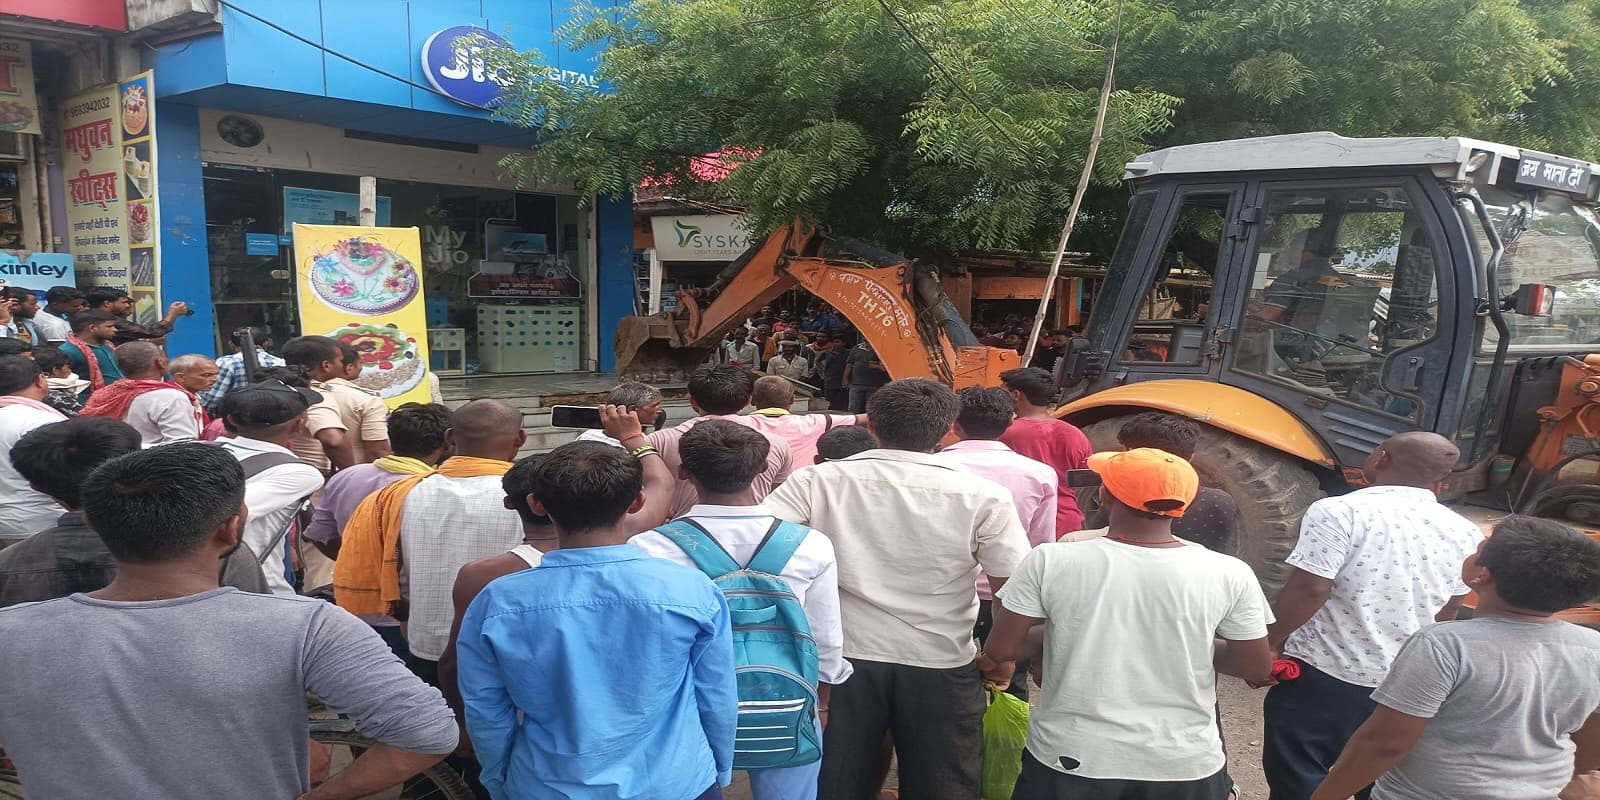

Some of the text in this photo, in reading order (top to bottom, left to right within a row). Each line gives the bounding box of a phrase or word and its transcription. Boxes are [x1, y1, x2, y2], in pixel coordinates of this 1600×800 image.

[1521, 159, 1541, 179] जय
[1543, 163, 1569, 187] माता
[425, 225, 467, 249] My
[428, 245, 469, 264] Jio
